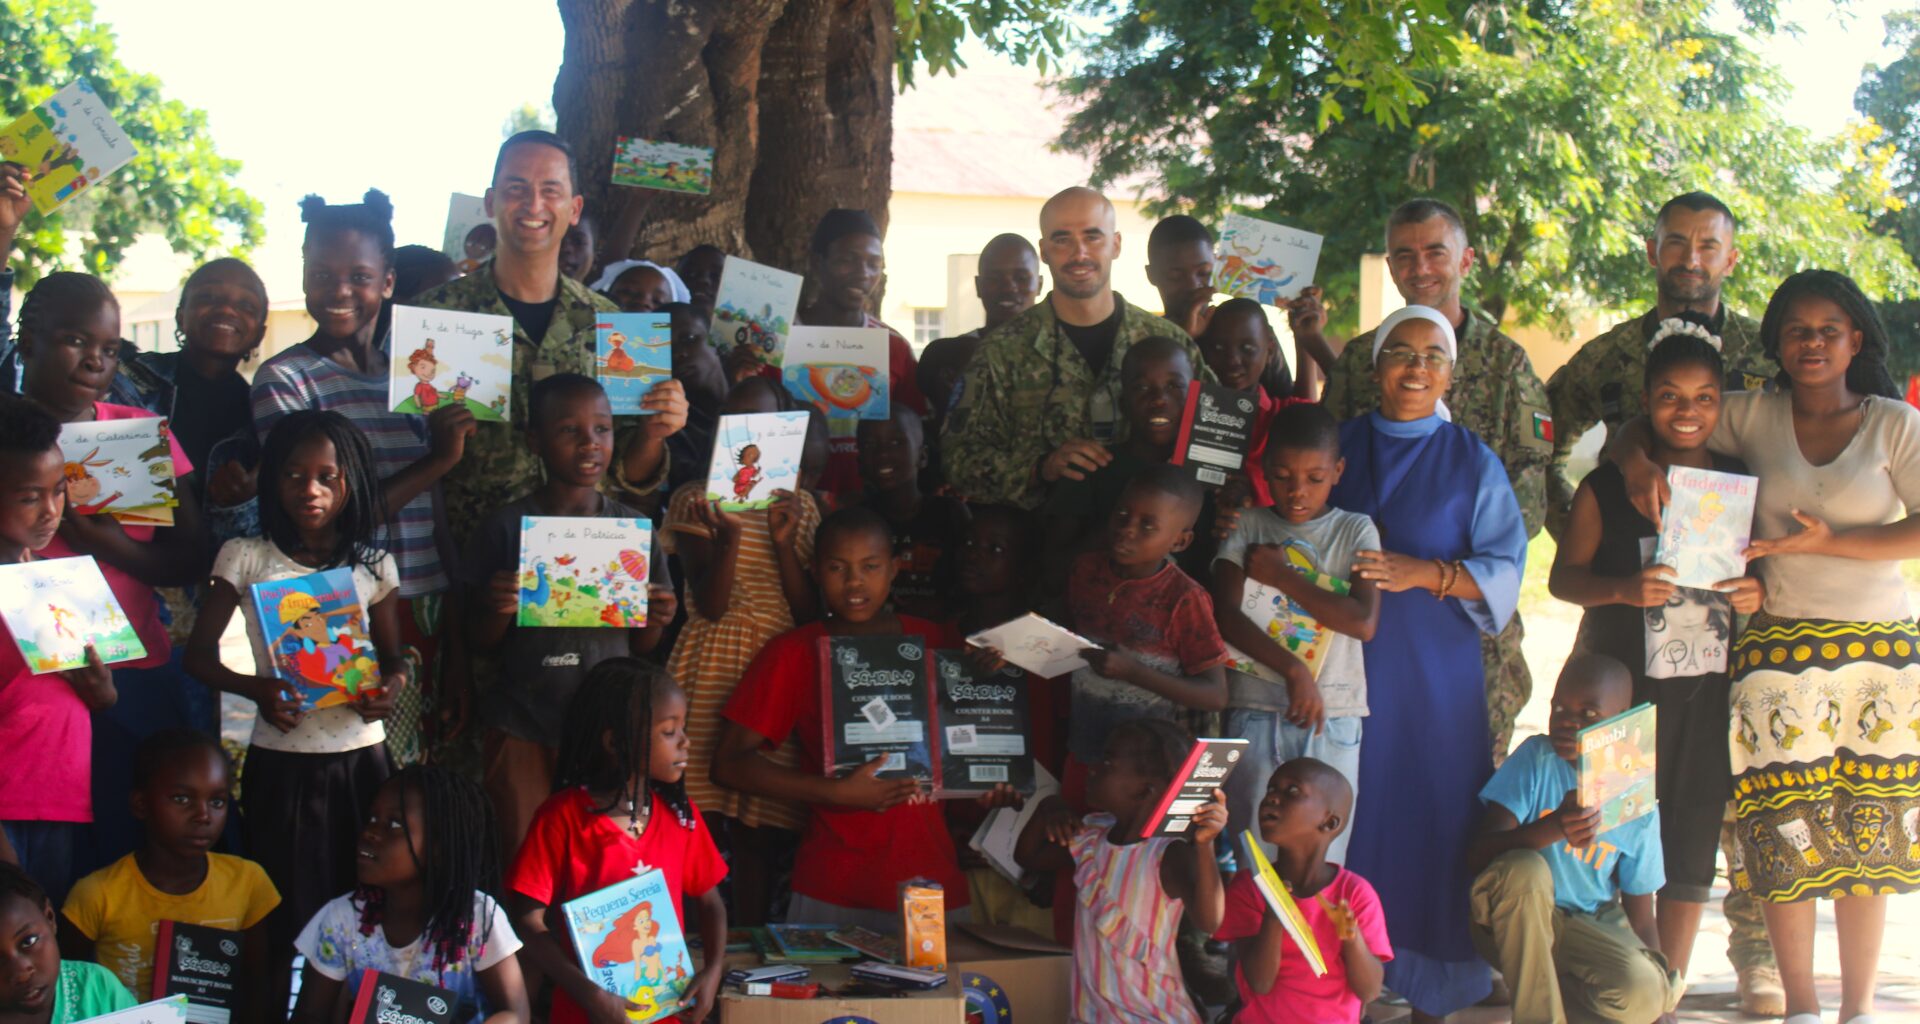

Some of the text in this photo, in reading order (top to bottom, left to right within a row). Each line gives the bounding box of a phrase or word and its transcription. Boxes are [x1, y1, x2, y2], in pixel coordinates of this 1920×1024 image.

[455, 323, 484, 341] Hugo
[96, 431, 153, 443] Catarina
[1670, 470, 1749, 497] Cinderela
[563, 528, 577, 538] de
[1585, 725, 1627, 751] Bambi
[573, 882, 662, 923] A Pequena Sereia
